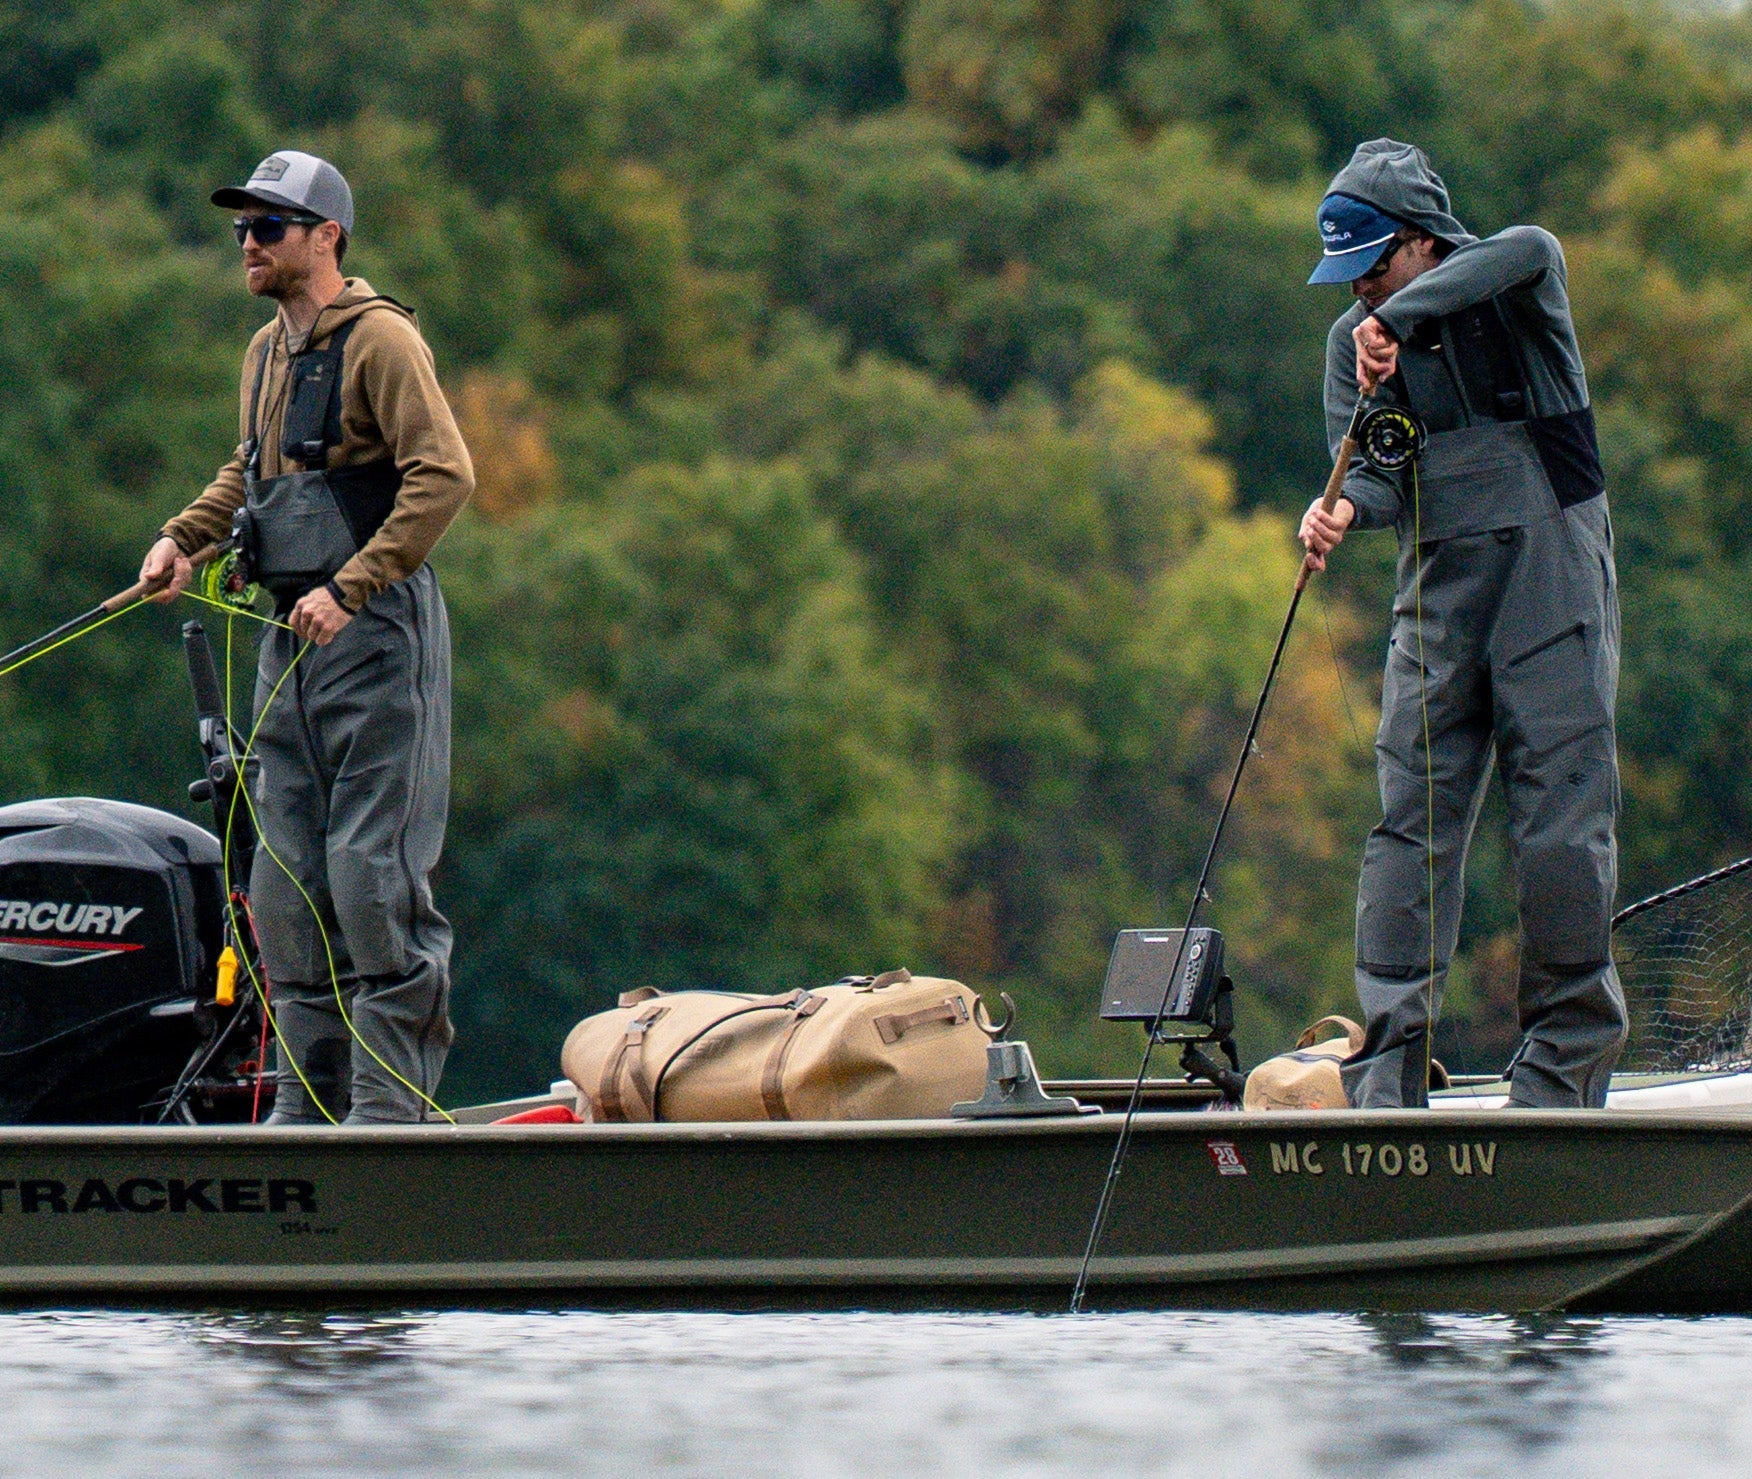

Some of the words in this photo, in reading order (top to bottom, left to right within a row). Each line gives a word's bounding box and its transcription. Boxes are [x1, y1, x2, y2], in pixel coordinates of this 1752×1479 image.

[1213, 1146, 1239, 1165] 28
[1269, 1141, 1324, 1175] MC
[1342, 1142, 1429, 1176] 1708
[1448, 1141, 1497, 1176] UV
